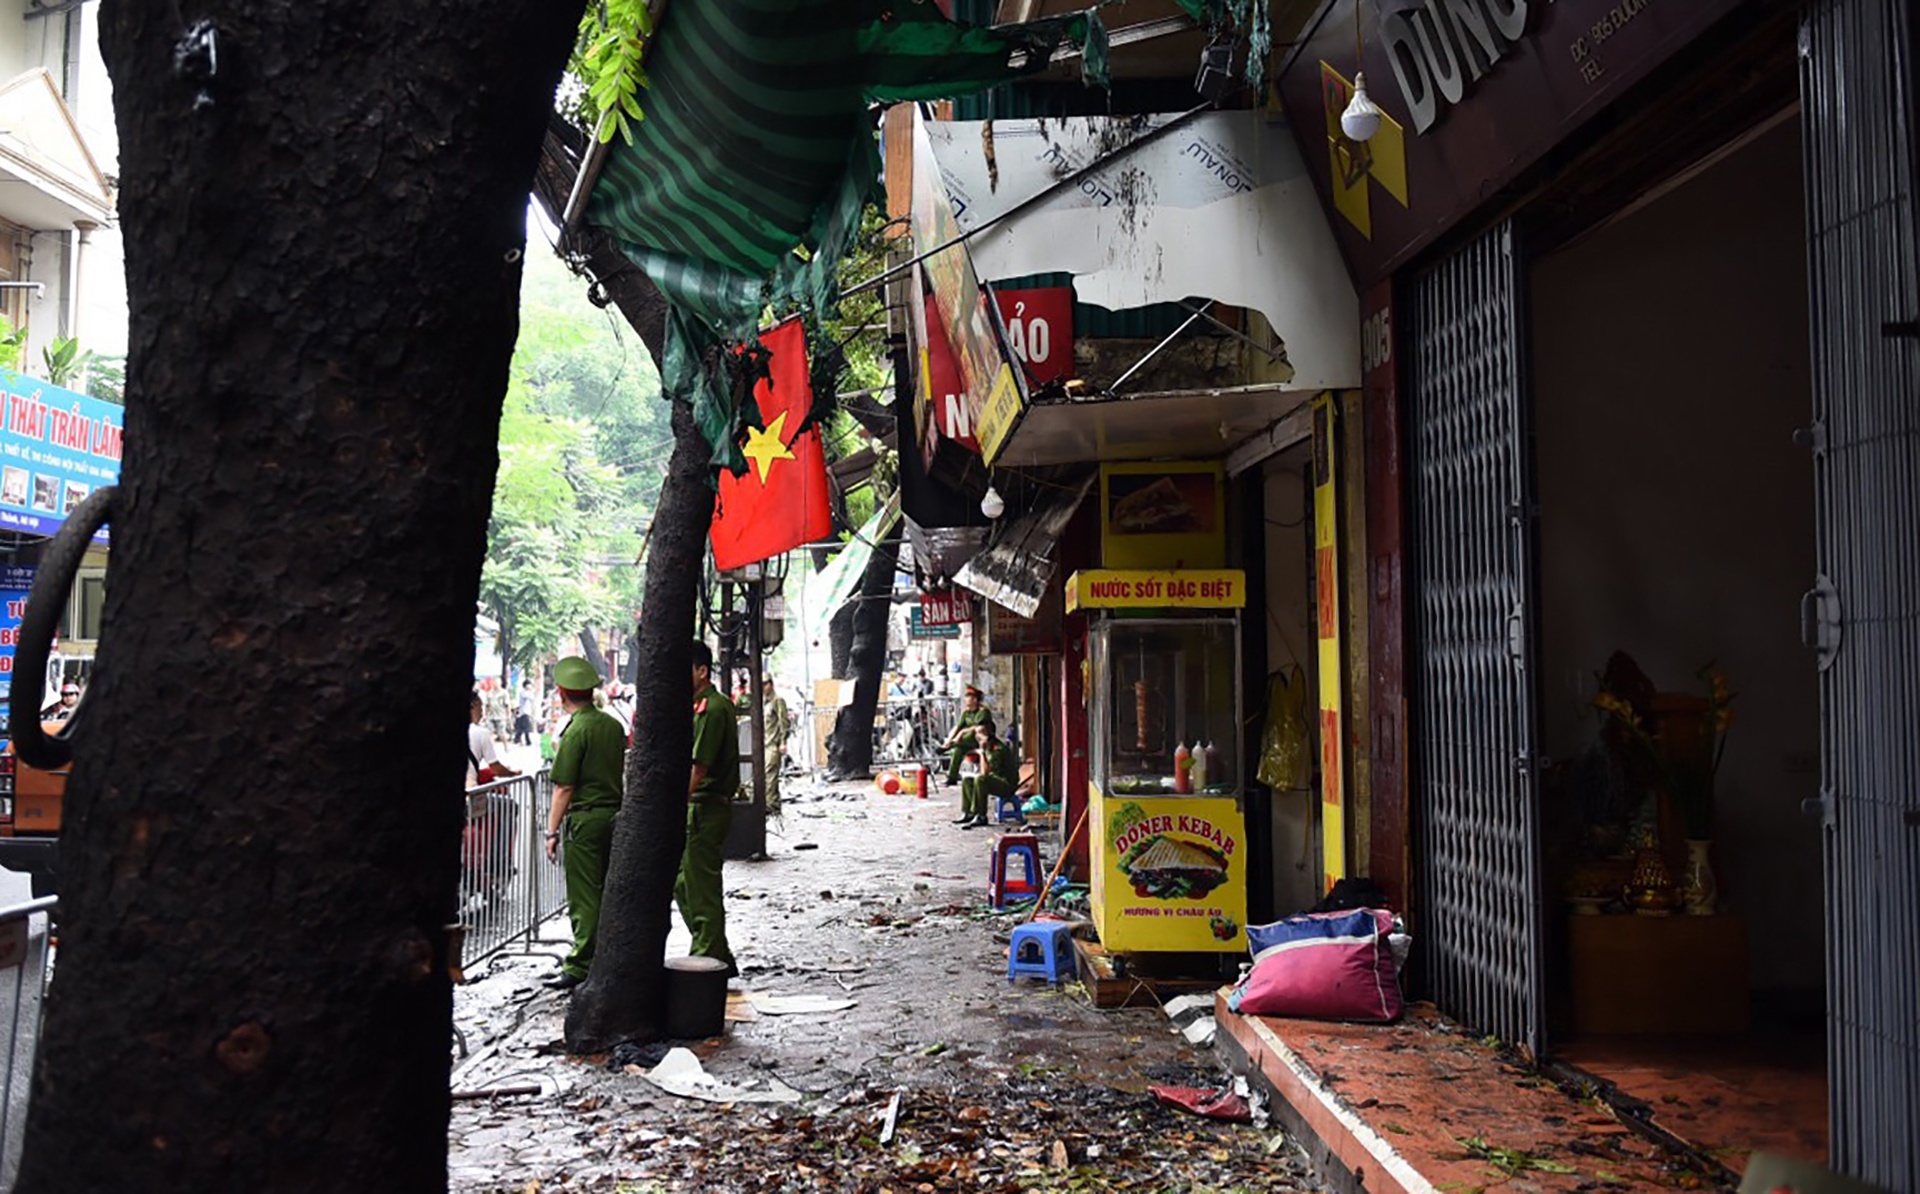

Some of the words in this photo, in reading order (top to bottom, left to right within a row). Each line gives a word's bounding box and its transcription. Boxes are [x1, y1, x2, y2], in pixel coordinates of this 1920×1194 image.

[1090, 577, 1131, 598] NƯỚC
[1135, 576, 1162, 598] SỐT
[1201, 578, 1232, 601] BIỆT
[1178, 815, 1236, 855] KEBAB
